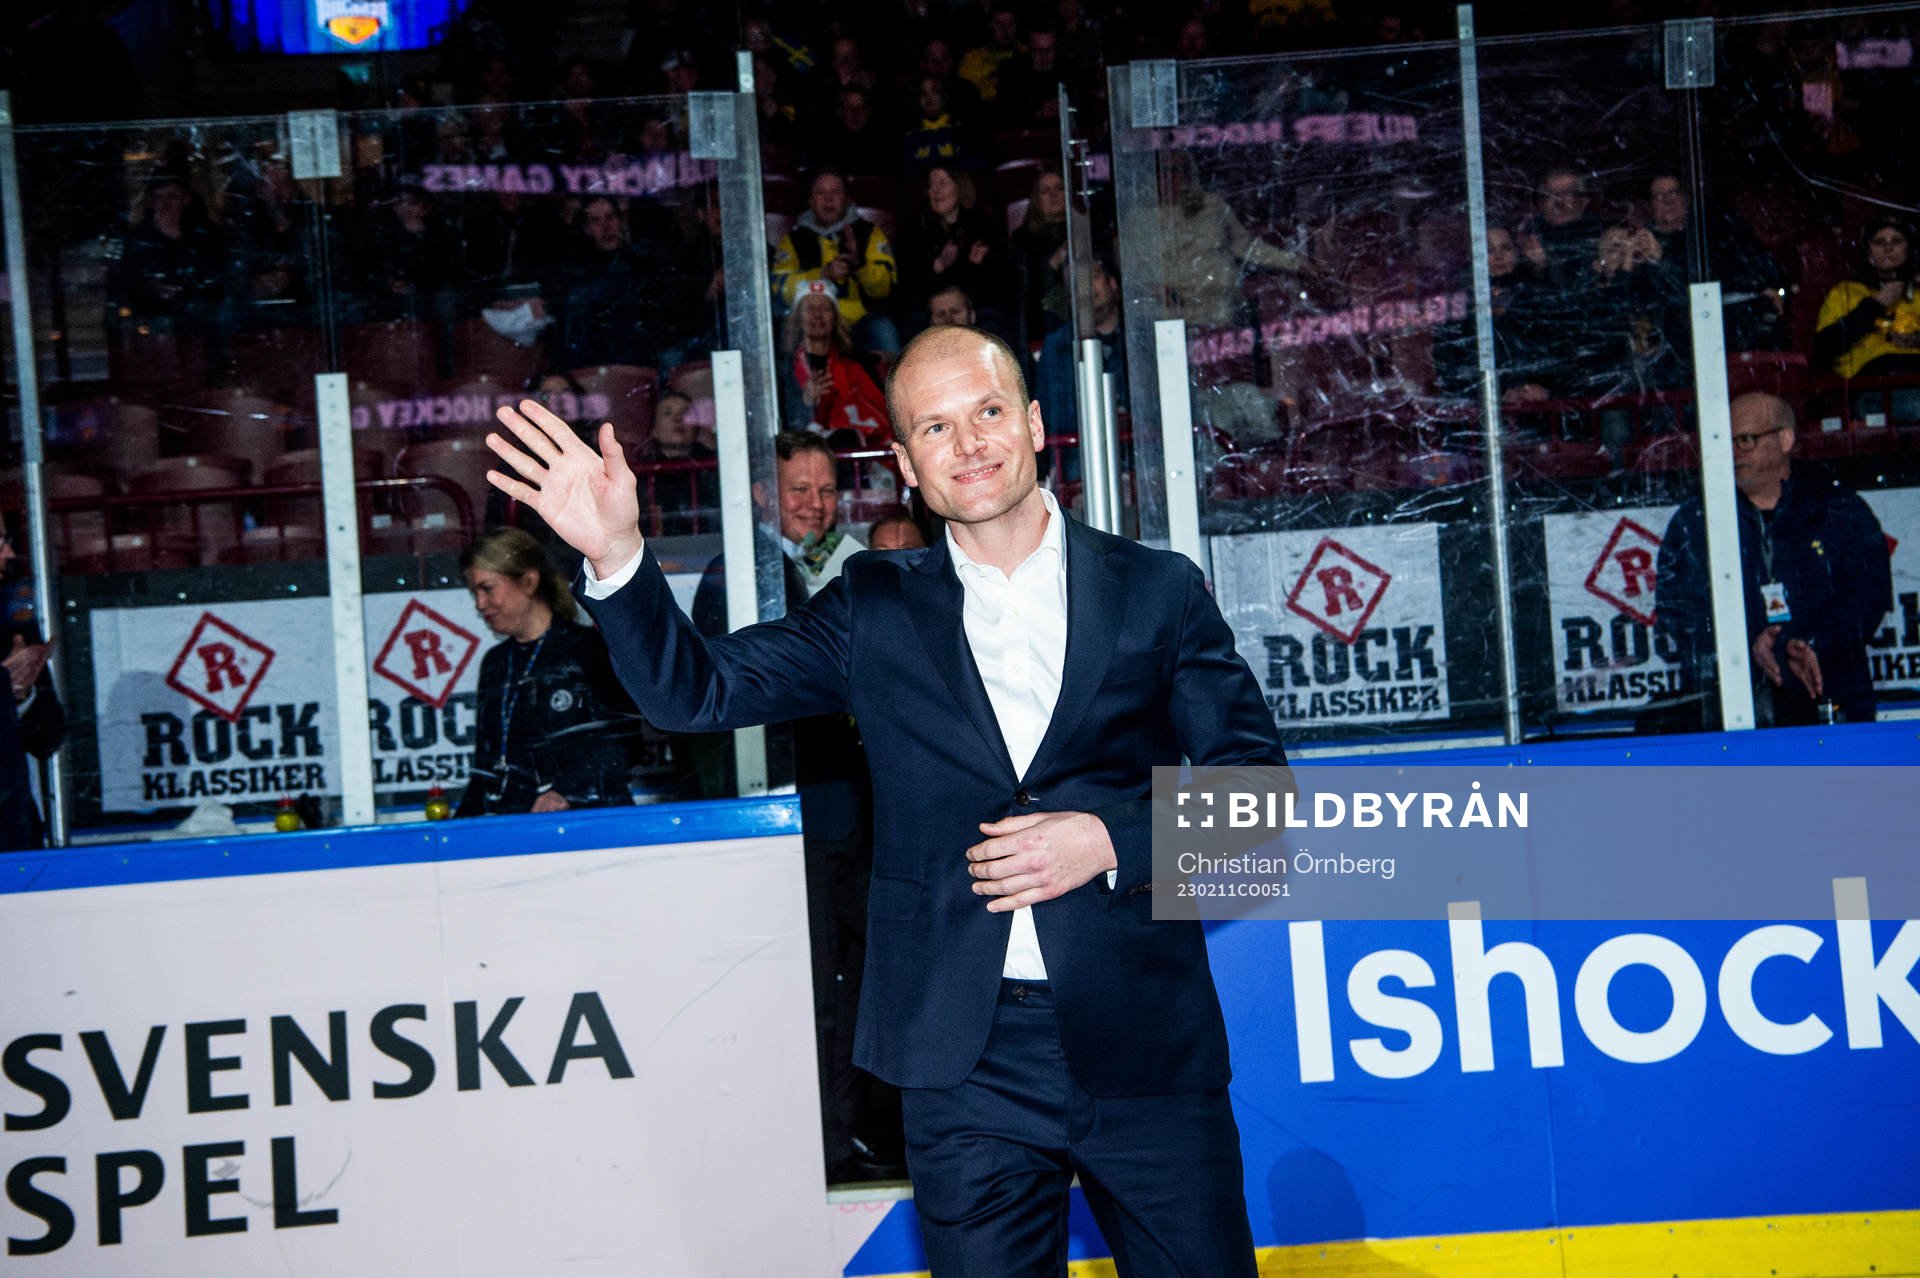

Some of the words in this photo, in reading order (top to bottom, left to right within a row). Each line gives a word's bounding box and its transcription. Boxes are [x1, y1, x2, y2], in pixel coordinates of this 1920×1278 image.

[1316, 566, 1364, 616] R
[196, 642, 246, 693] R
[404, 629, 452, 680] R
[1263, 625, 1439, 689] ROCK
[369, 692, 477, 751] ROC
[1265, 685, 1442, 719] KLASSIKER
[140, 702, 324, 766] ROCK
[142, 764, 326, 800] KLASSIKER
[1289, 876, 1920, 1084] Ishock
[3, 991, 635, 1132] SVENSKA
[6, 1136, 340, 1257] SPEL
